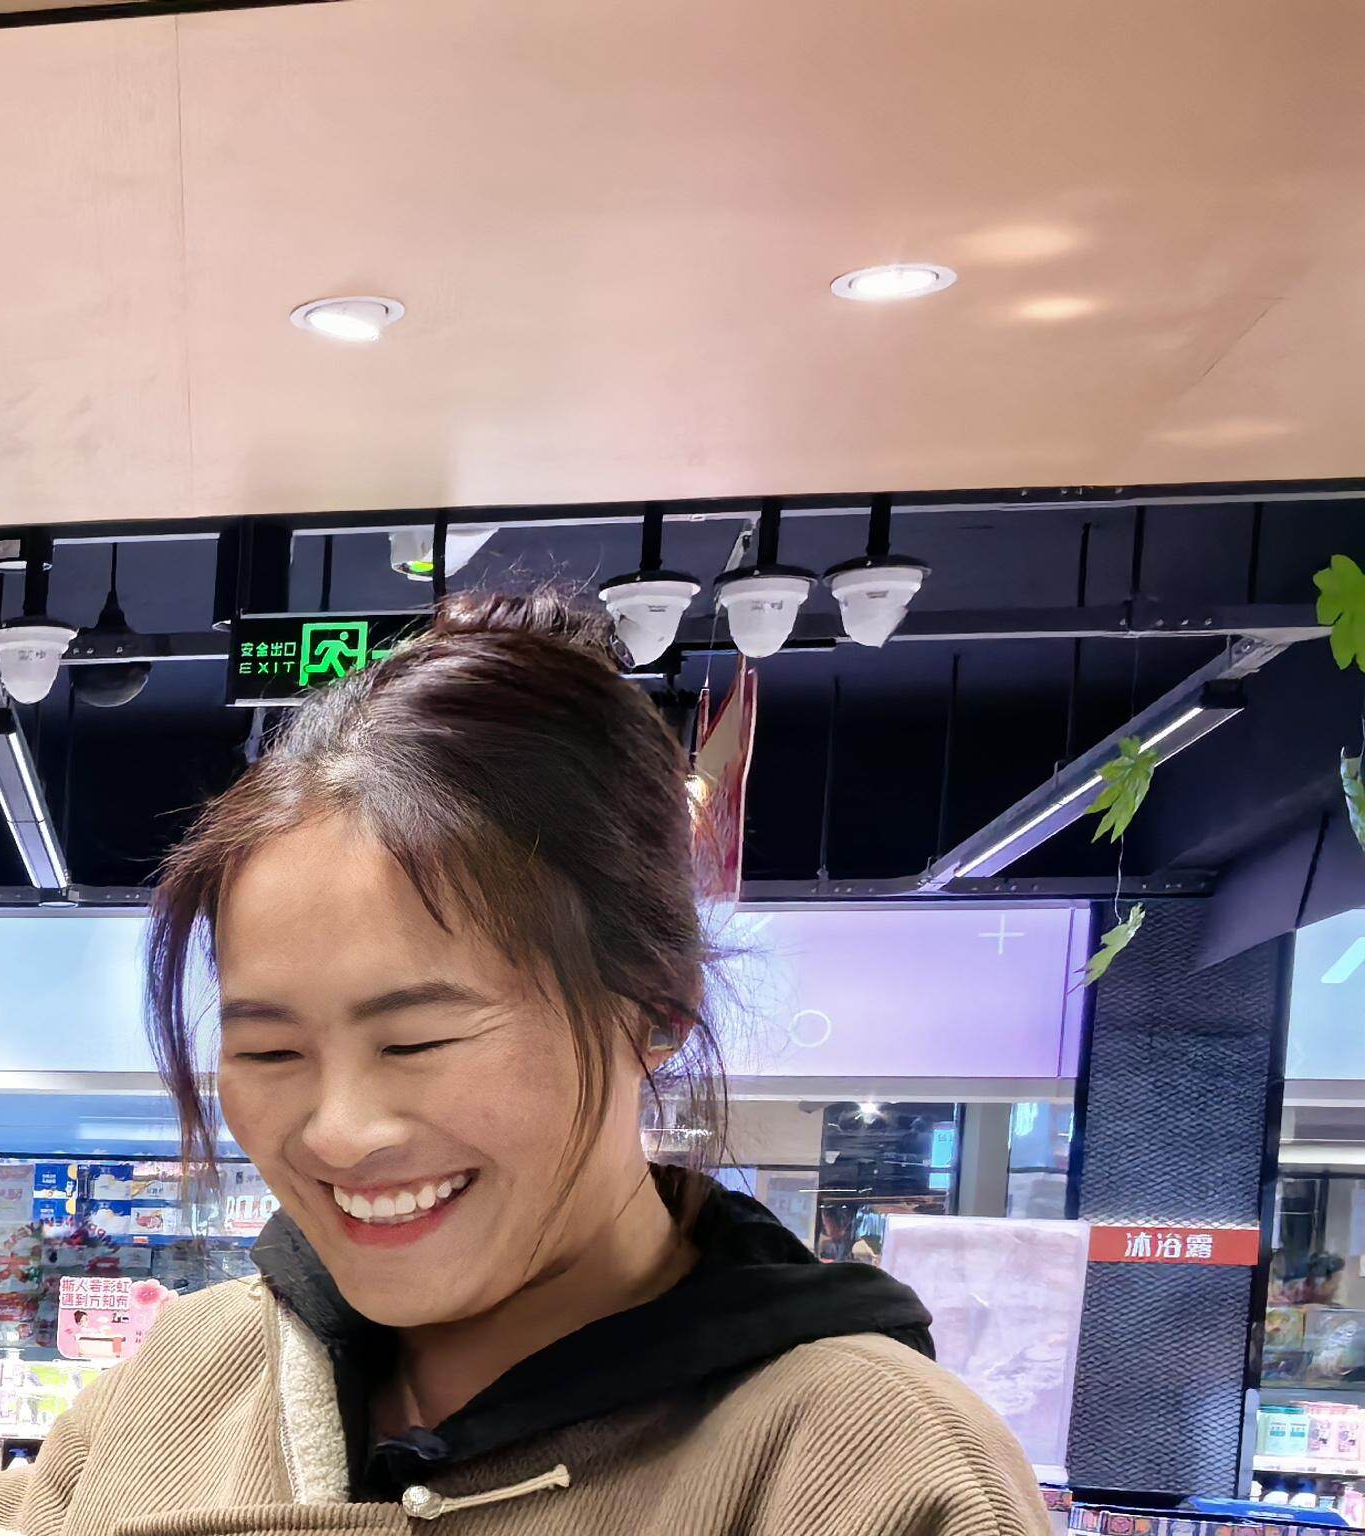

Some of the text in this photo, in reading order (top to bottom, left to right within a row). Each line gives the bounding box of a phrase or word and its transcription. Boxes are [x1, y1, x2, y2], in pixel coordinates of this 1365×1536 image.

[240, 641, 297, 658] 安全出口
[238, 661, 296, 675] EXIT
[1124, 1232, 1213, 1258] 沐浴露
